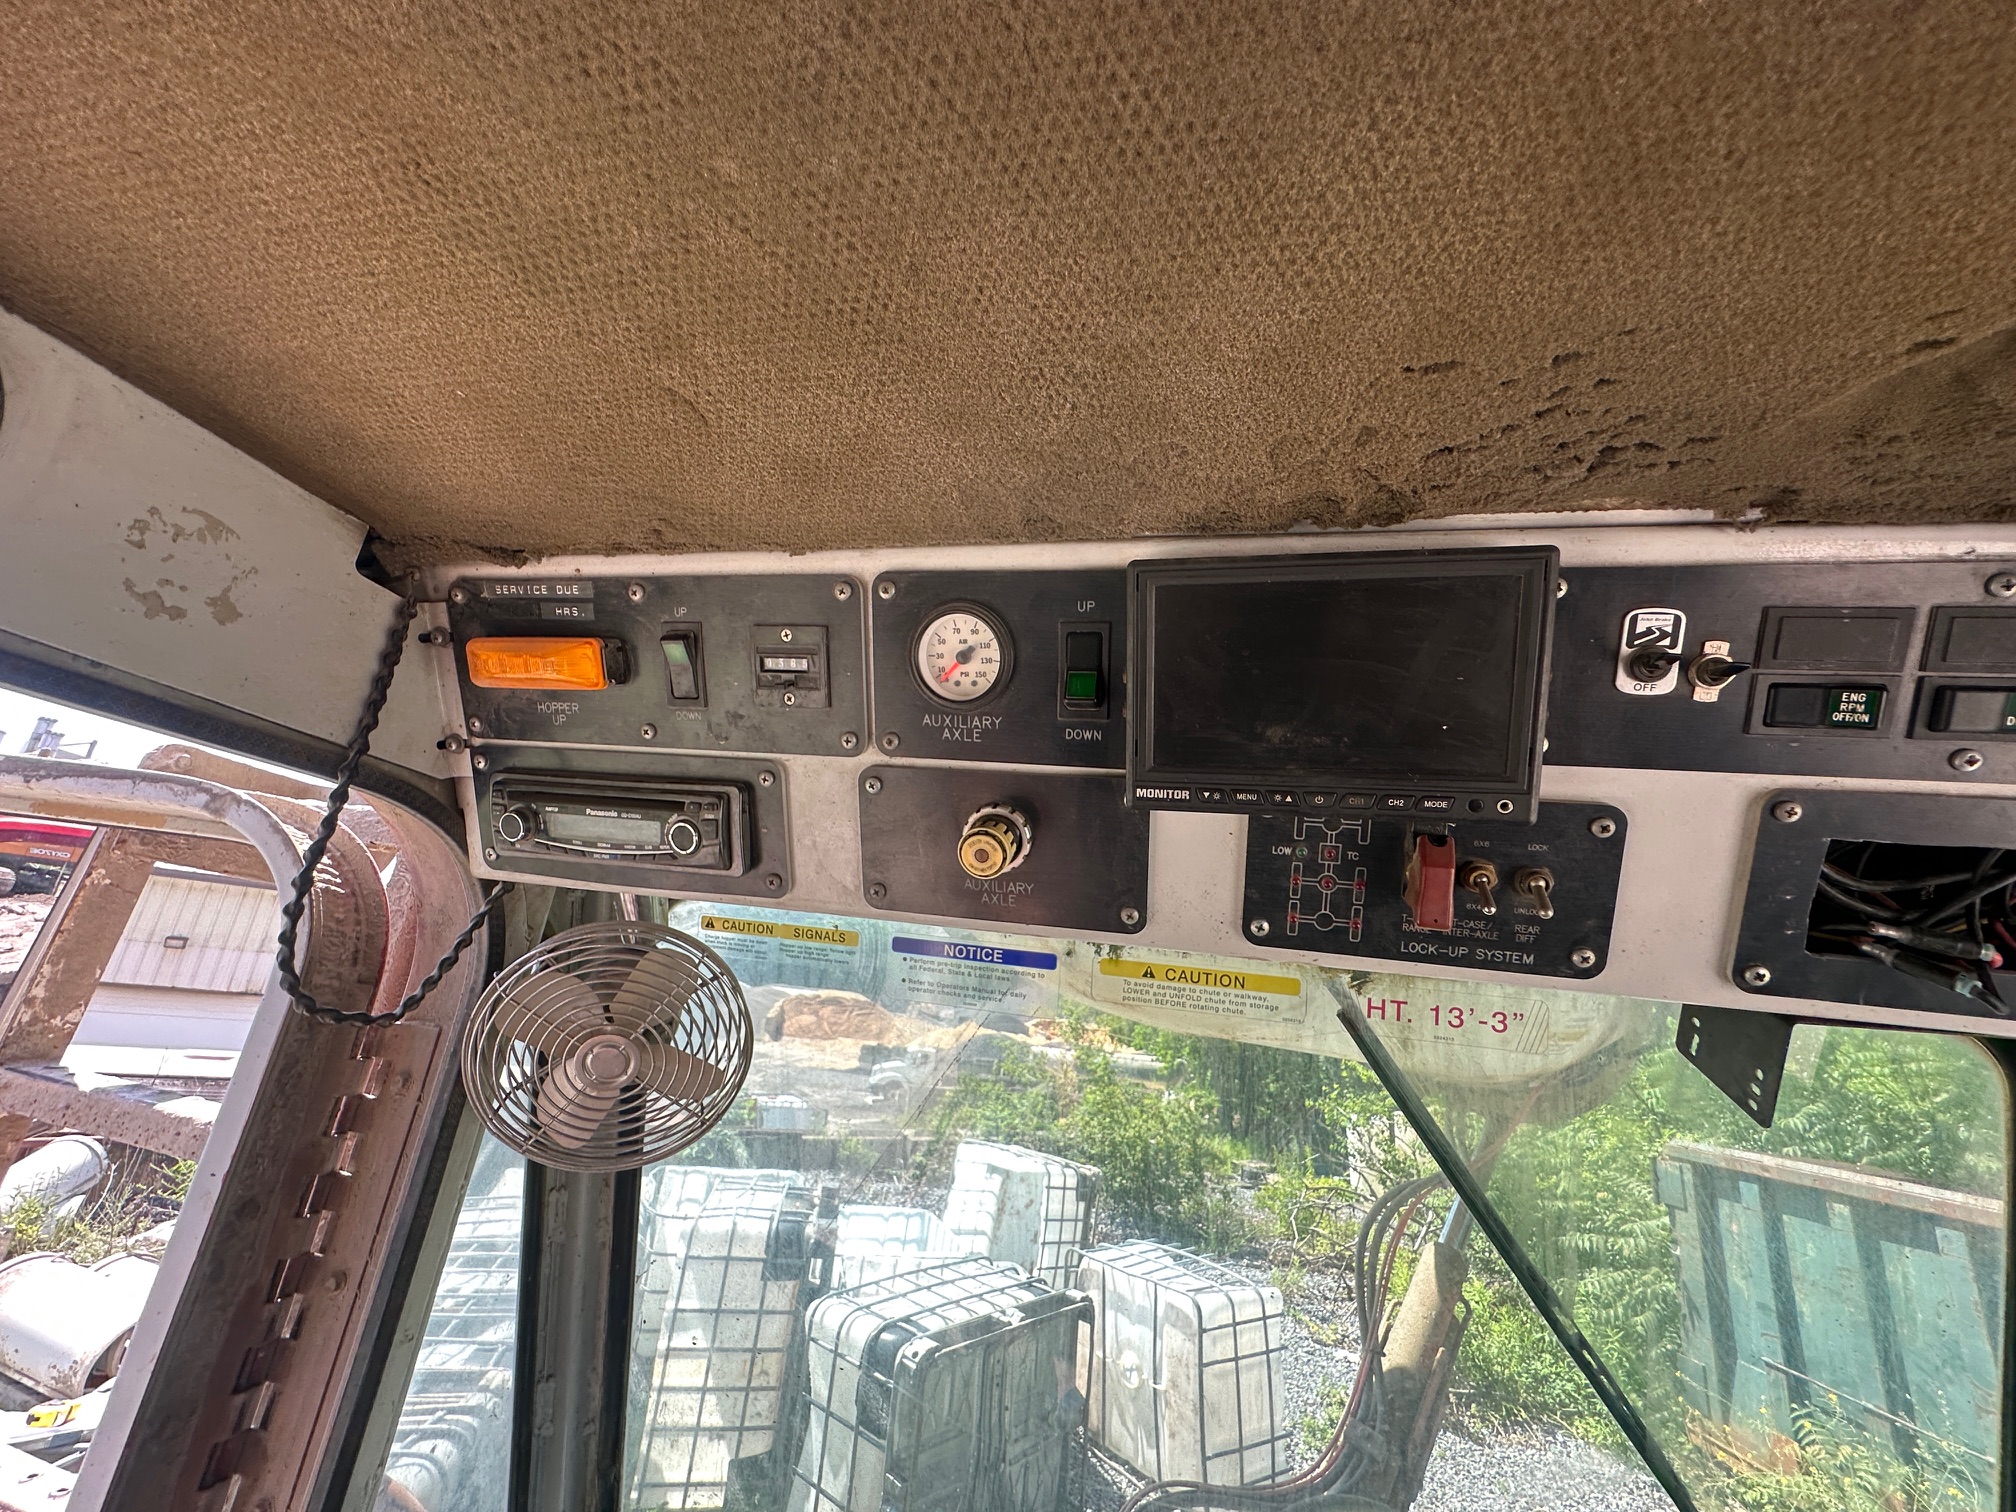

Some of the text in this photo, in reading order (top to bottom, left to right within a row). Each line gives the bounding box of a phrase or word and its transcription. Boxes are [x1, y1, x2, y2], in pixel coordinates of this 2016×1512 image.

[496, 585, 579, 594] SERVICE DUE
[556, 608, 584, 616] HRS.
[675, 607, 687, 617] UP
[1078, 601, 1095, 612] UP
[1842, 693, 1866, 702] ENG
[538, 702, 579, 714] HOPPER
[1840, 703, 1865, 712] RPM
[553, 715, 566, 725] UP
[676, 712, 701, 720] DOWN
[923, 714, 1002, 729] AUXILIARY
[1832, 712, 1870, 722] OFF/ON
[942, 729, 982, 742] AXLE
[1066, 729, 1102, 740] DOWN
[1136, 788, 1189, 800] MONITOR
[586, 808, 618, 817] Panasonic
[1474, 840, 1490, 848] 6X6
[1272, 846, 1292, 855] LOW
[1347, 852, 1359, 860] TC
[964, 879, 1034, 894] AUXILIARY
[982, 893, 1016, 906] AXLE
[722, 920, 773, 934] CAUTION
[1515, 924, 1540, 934] REAR
[794, 928, 846, 942] SIGNALS
[1516, 934, 1537, 943] DIFF
[944, 944, 1003, 962] NOTICE
[1401, 942, 1534, 965] LOCK-UP SYSTEM
[910, 957, 935, 965] Perform
[937, 961, 962, 969] pre-trip
[964, 963, 999, 972] inspection
[1001, 969, 1036, 978] according
[1165, 968, 1245, 989] CAUTION
[908, 986, 935, 994] operator
[937, 982, 969, 991] Operators
[972, 986, 996, 994] Manual
[1010, 991, 1027, 999] daily
[1157, 984, 1186, 993] damage
[1199, 988, 1220, 996] chute
[1234, 992, 1269, 1003] walkway.
[1123, 987, 1150, 995] LOWER
[1169, 992, 1202, 1002] UNFOLD
[1204, 996, 1226, 1005] chute
[1229, 999, 1246, 1007] from
[1250, 1002, 1279, 1012] storage
[1123, 995, 1246, 1015] position BEFORE rotating chute.
[1367, 998, 1524, 1033] HT. 13'-3"
